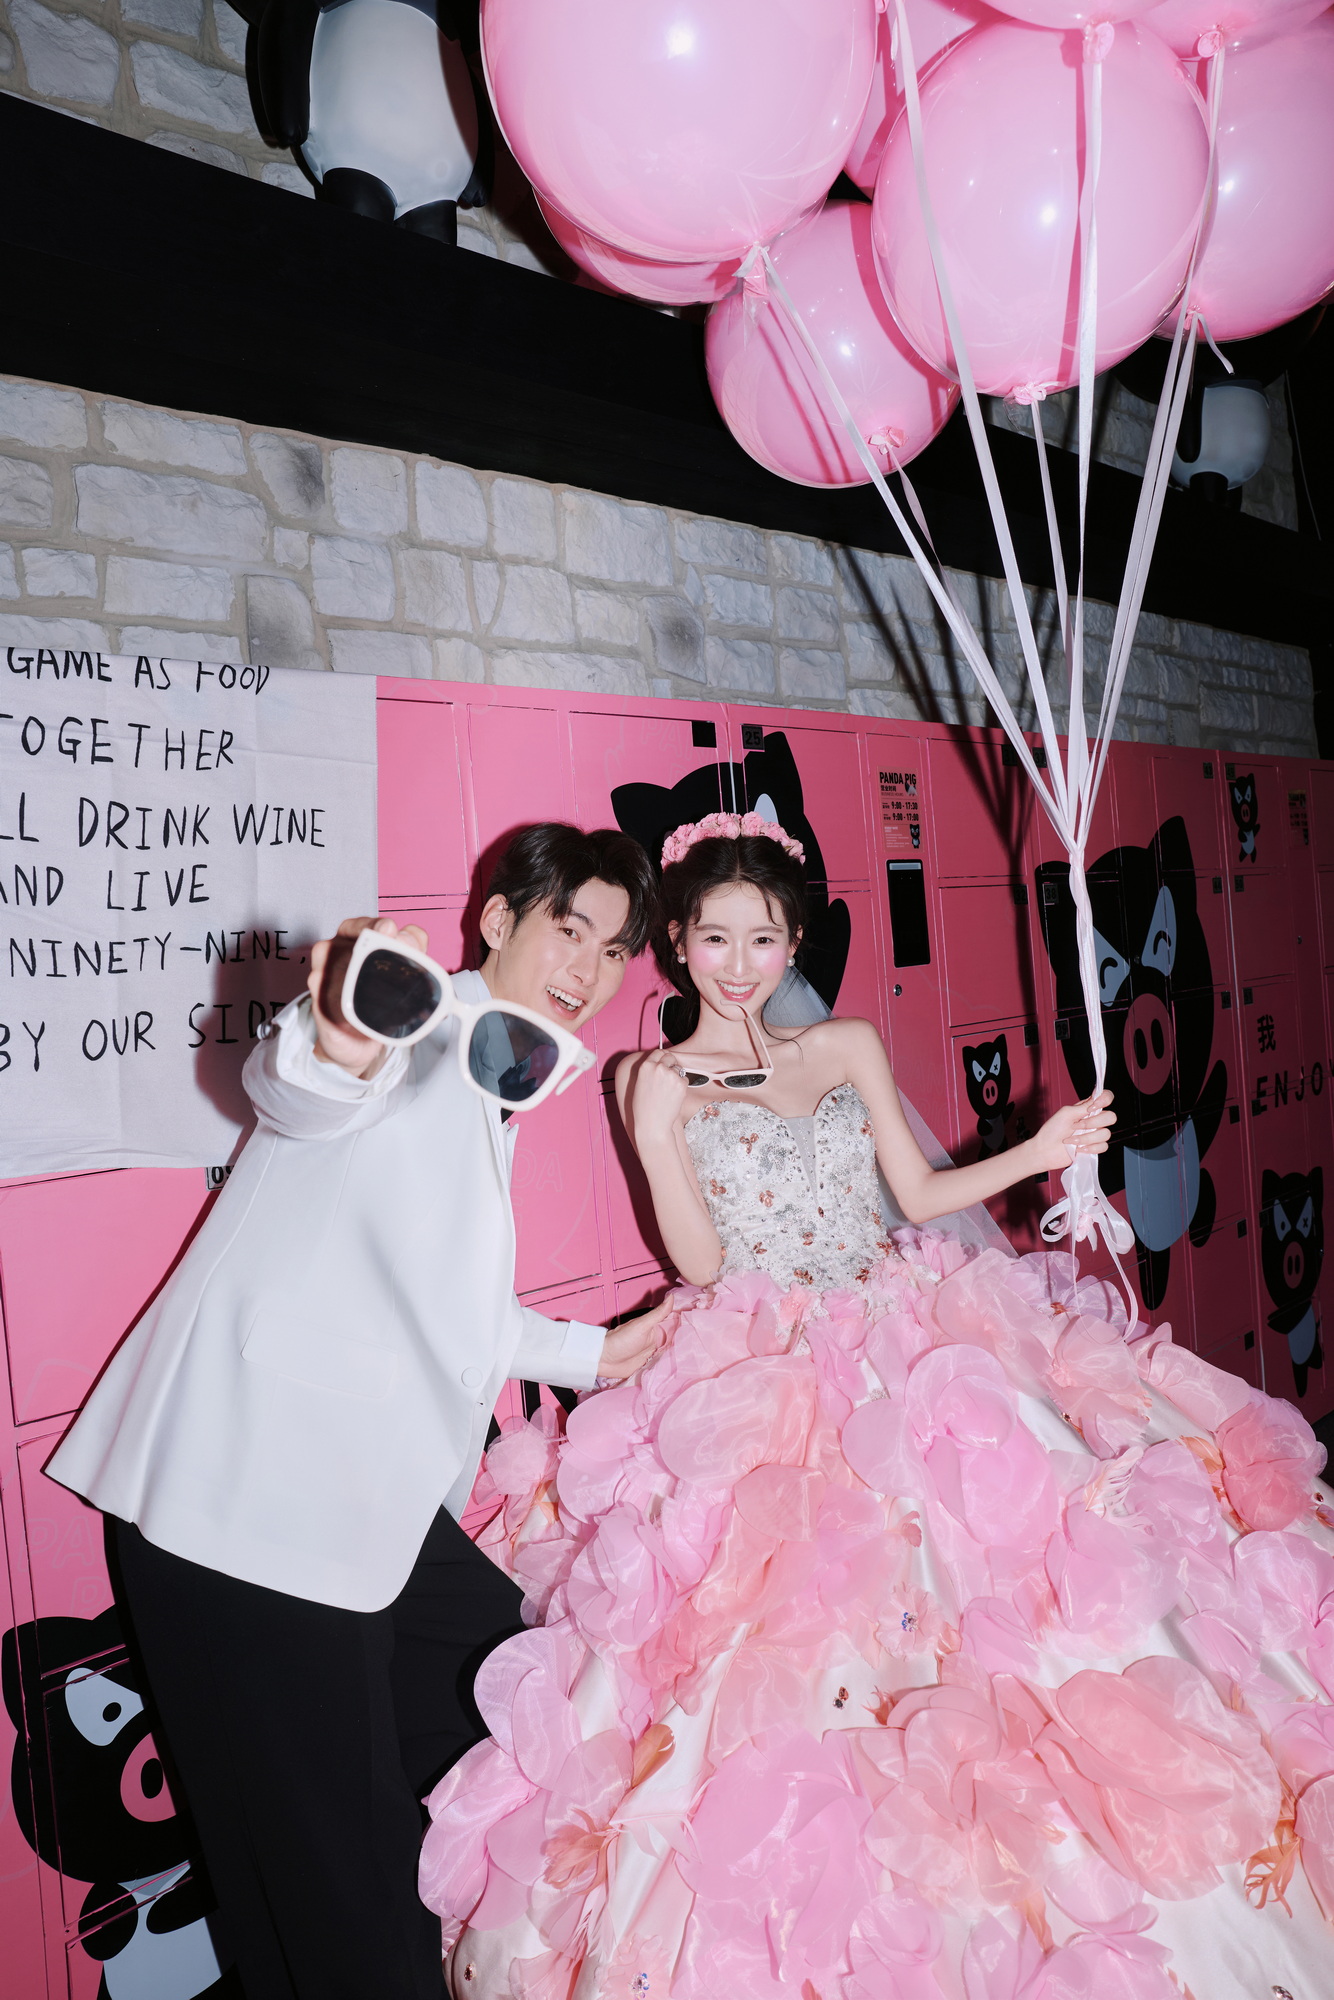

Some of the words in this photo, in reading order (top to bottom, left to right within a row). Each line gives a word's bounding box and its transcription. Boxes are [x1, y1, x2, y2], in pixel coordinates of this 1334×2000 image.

[6, 646, 113, 682] GAME
[134, 655, 172, 690] AS
[745, 731, 761, 745] 25
[1034, 752, 1045, 763] 37
[879, 771, 904, 785] PANDA
[904, 773, 917, 785] PIG
[0, 791, 40, 843] L
[78, 796, 211, 851] DRINK
[233, 804, 326, 849] WINE
[106, 863, 211, 912] LIVE
[1045, 887, 1056, 899] 38
[1016, 889, 1026, 901] 32
[82, 1011, 157, 1062] OUR
[1057, 1023, 1067, 1036] 39
[1257, 1014, 1276, 1053] 我
